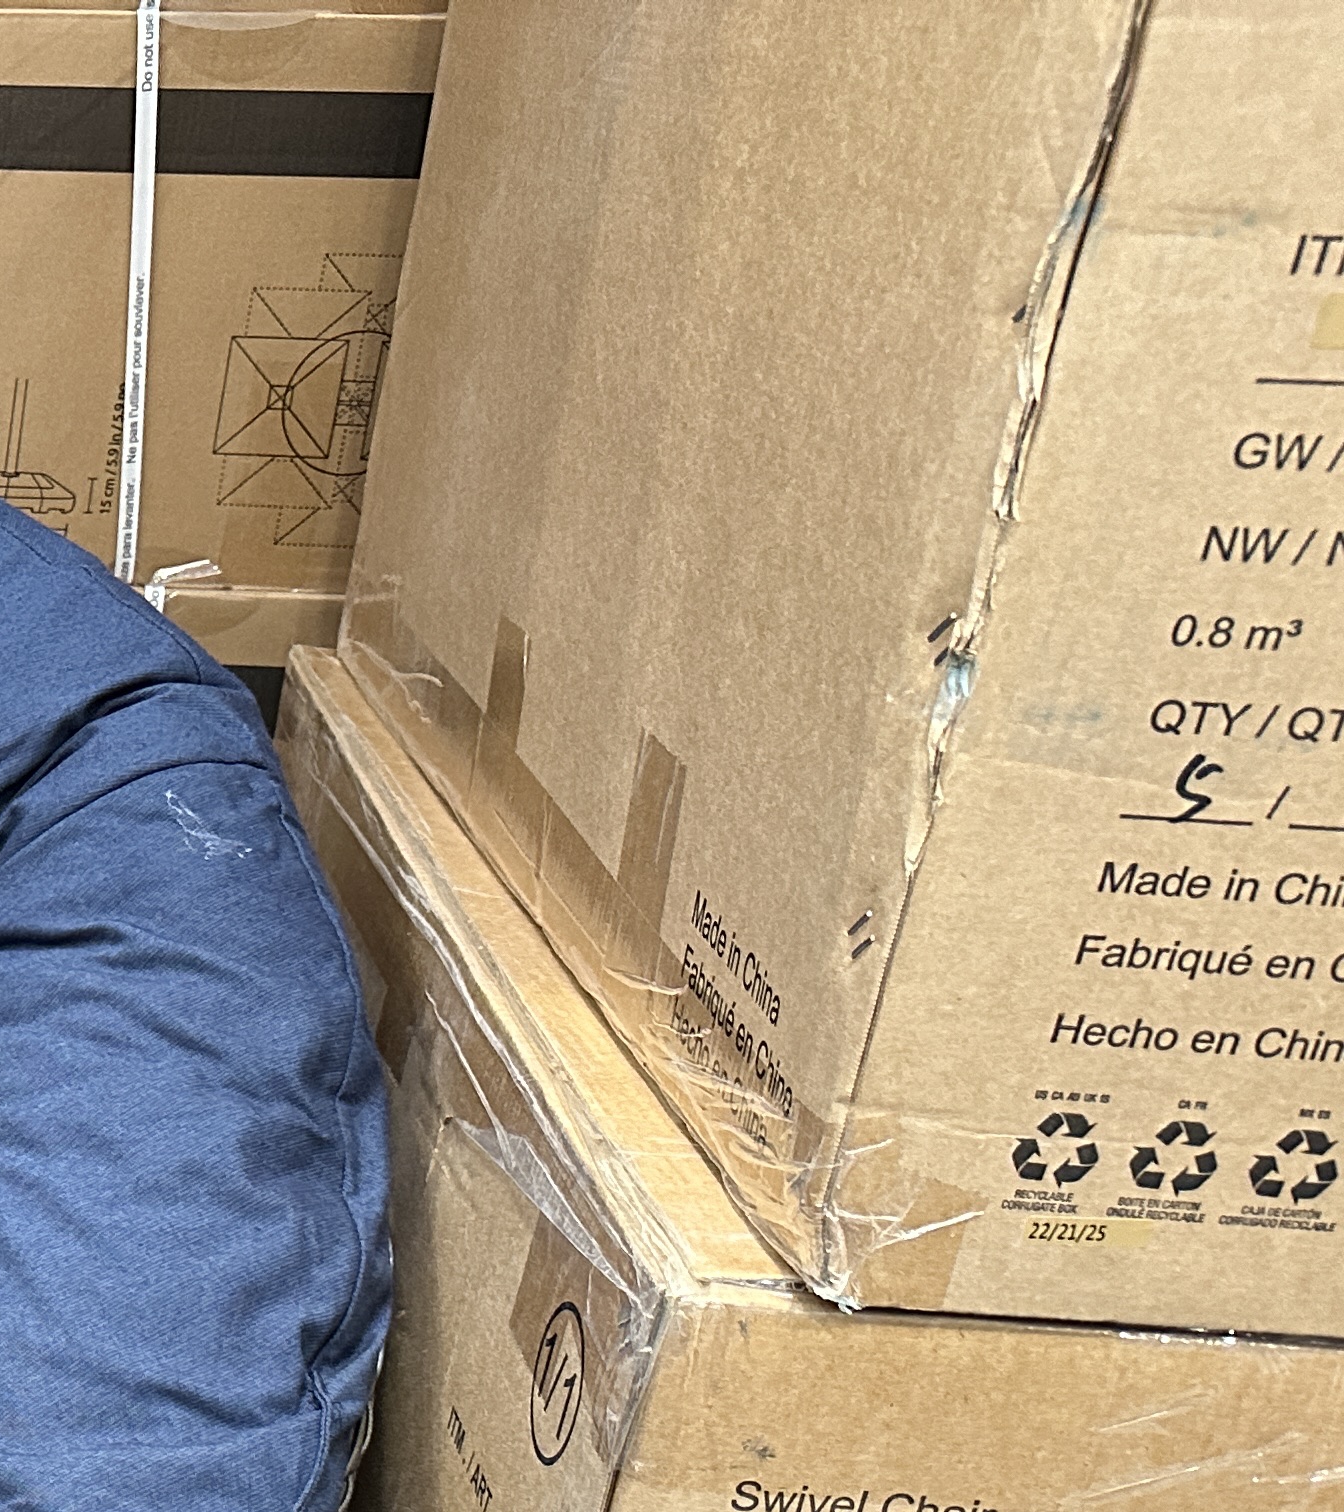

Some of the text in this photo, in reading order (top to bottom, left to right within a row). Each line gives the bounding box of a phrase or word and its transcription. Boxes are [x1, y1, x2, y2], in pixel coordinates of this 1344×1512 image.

[141, 13, 155, 93] Do not use
[1233, 432, 1324, 472] GW
[1200, 525, 1290, 564] NW
[1171, 614, 1236, 649] 0.8
[1150, 699, 1253, 737] QTY
[1097, 861, 1344, 908] Made in Chi
[691, 889, 781, 1027] Made in China
[1074, 934, 1316, 981] Fabriqué en
[680, 944, 793, 1118] Fabriqué en China
[1049, 1012, 1344, 1063] Hecho en Chin
[1027, 1221, 1108, 1244] 22/21/25
